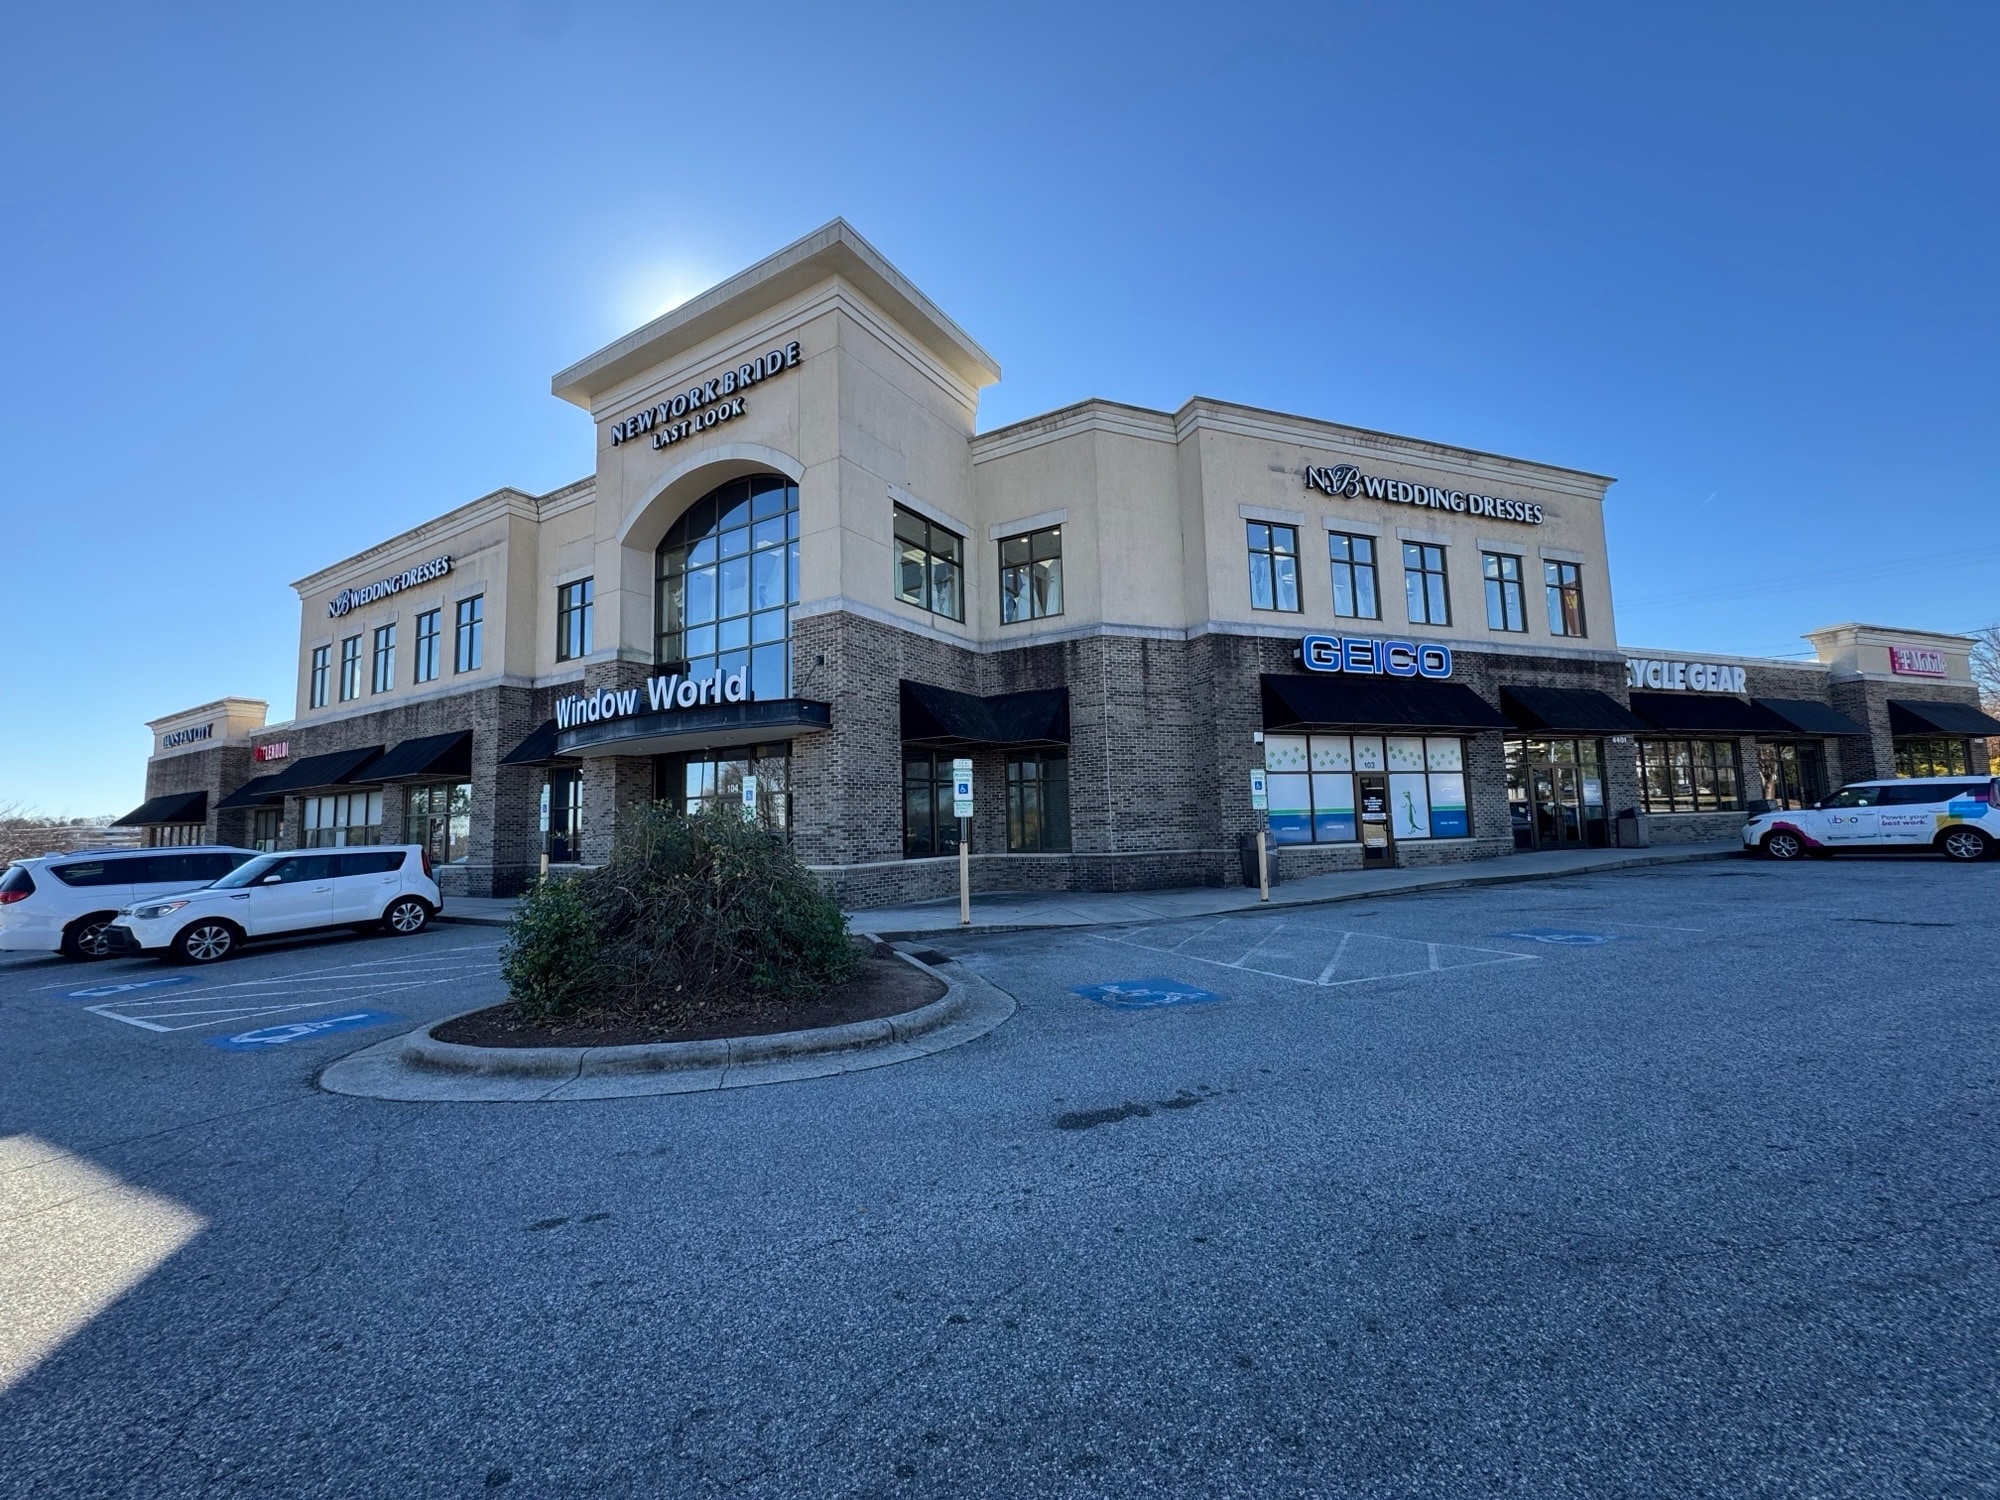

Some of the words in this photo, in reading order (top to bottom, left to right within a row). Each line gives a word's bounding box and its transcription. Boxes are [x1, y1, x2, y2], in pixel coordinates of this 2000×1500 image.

[611, 409, 656, 446] NEW
[657, 378, 721, 424] YORK
[722, 341, 803, 395] BRIDE
[652, 420, 691, 450] LAST
[694, 397, 746, 430] LOOK
[1362, 475, 1465, 512] WEDDING
[1467, 494, 1545, 525] DRESSES
[350, 575, 400, 608] WEDDING
[401, 555, 451, 589] DRESSES
[1303, 634, 1453, 680] GEICO
[1685, 662, 1747, 693] GEAR
[556, 687, 641, 730] Window
[647, 665, 751, 711] World
[726, 784, 739, 793] 104
[1364, 761, 1375, 769] 103
[1909, 814, 1929, 822] your
